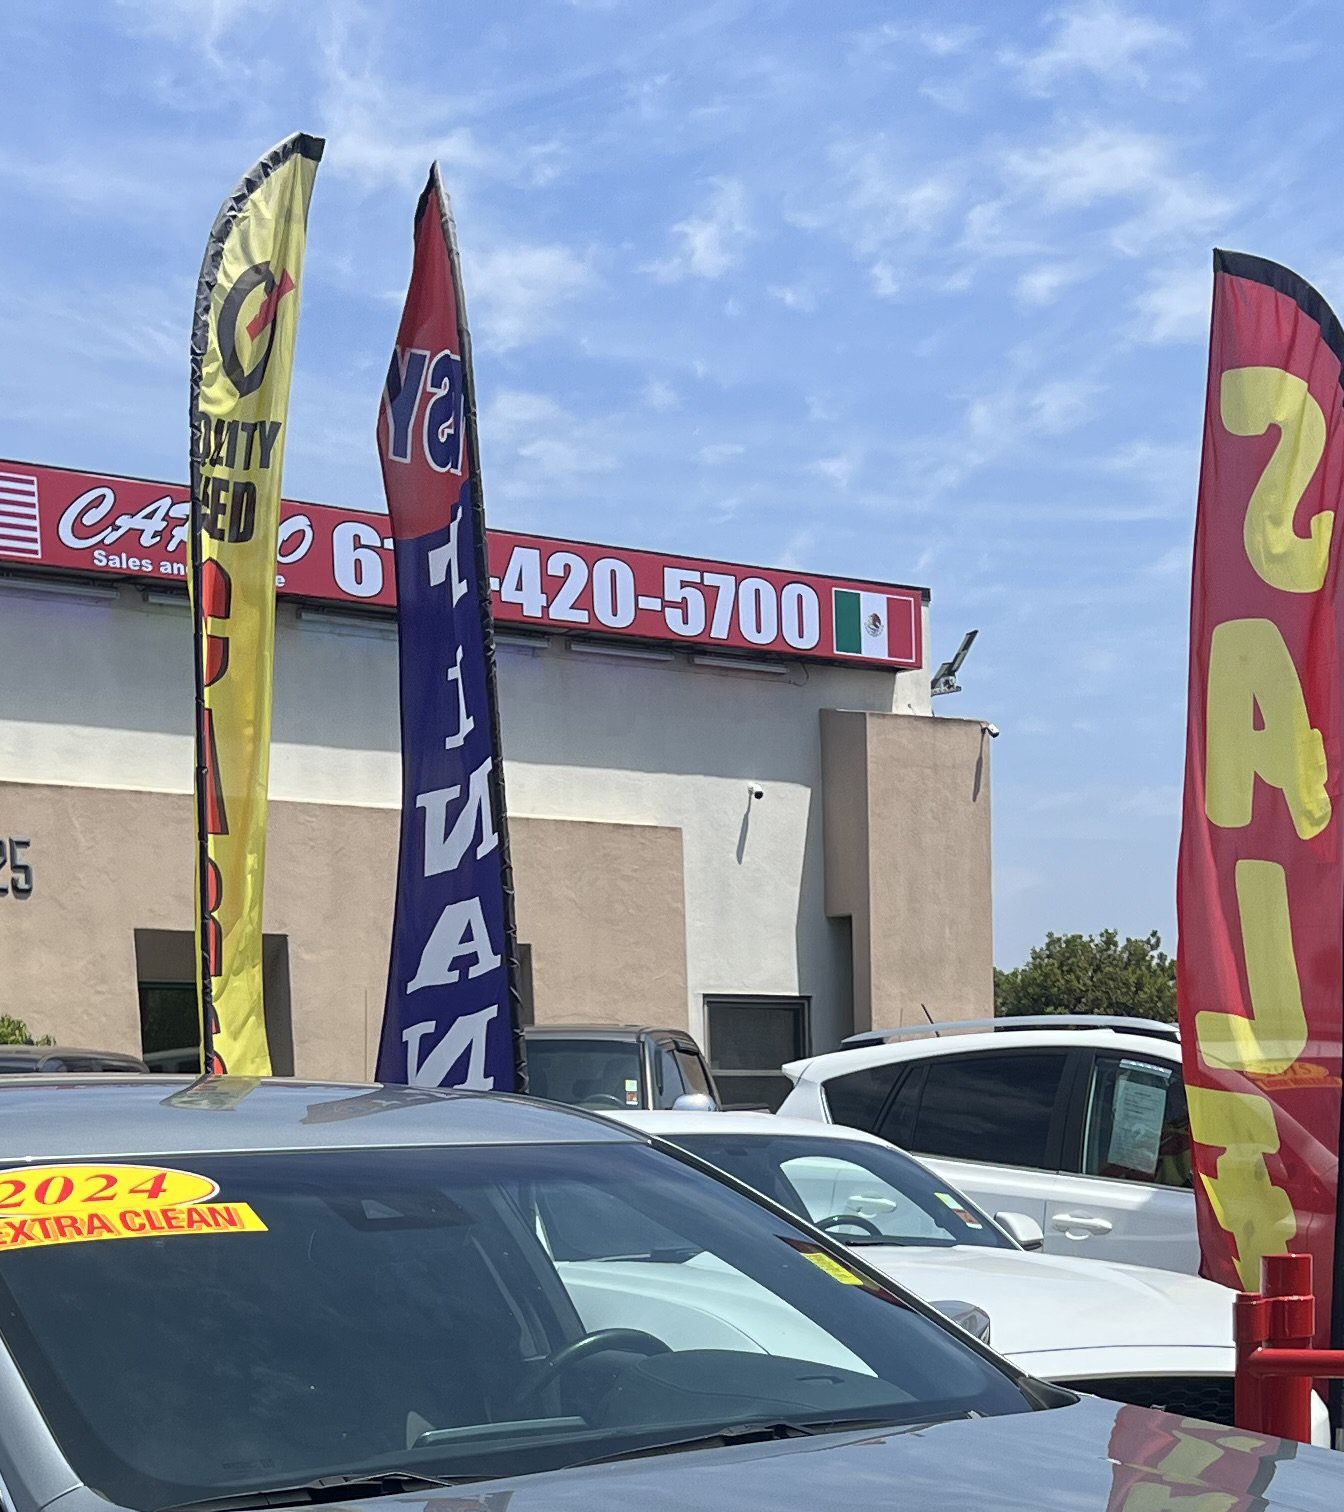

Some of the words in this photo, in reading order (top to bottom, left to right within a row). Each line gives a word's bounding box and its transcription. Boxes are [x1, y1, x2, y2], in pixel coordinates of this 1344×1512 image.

[58, 486, 314, 565] CAO
[332, 521, 820, 650] 6420-5700
[93, 549, 153, 575] Sales
[159, 560, 190, 576] an
[119, 1205, 240, 1233] CLEAN
